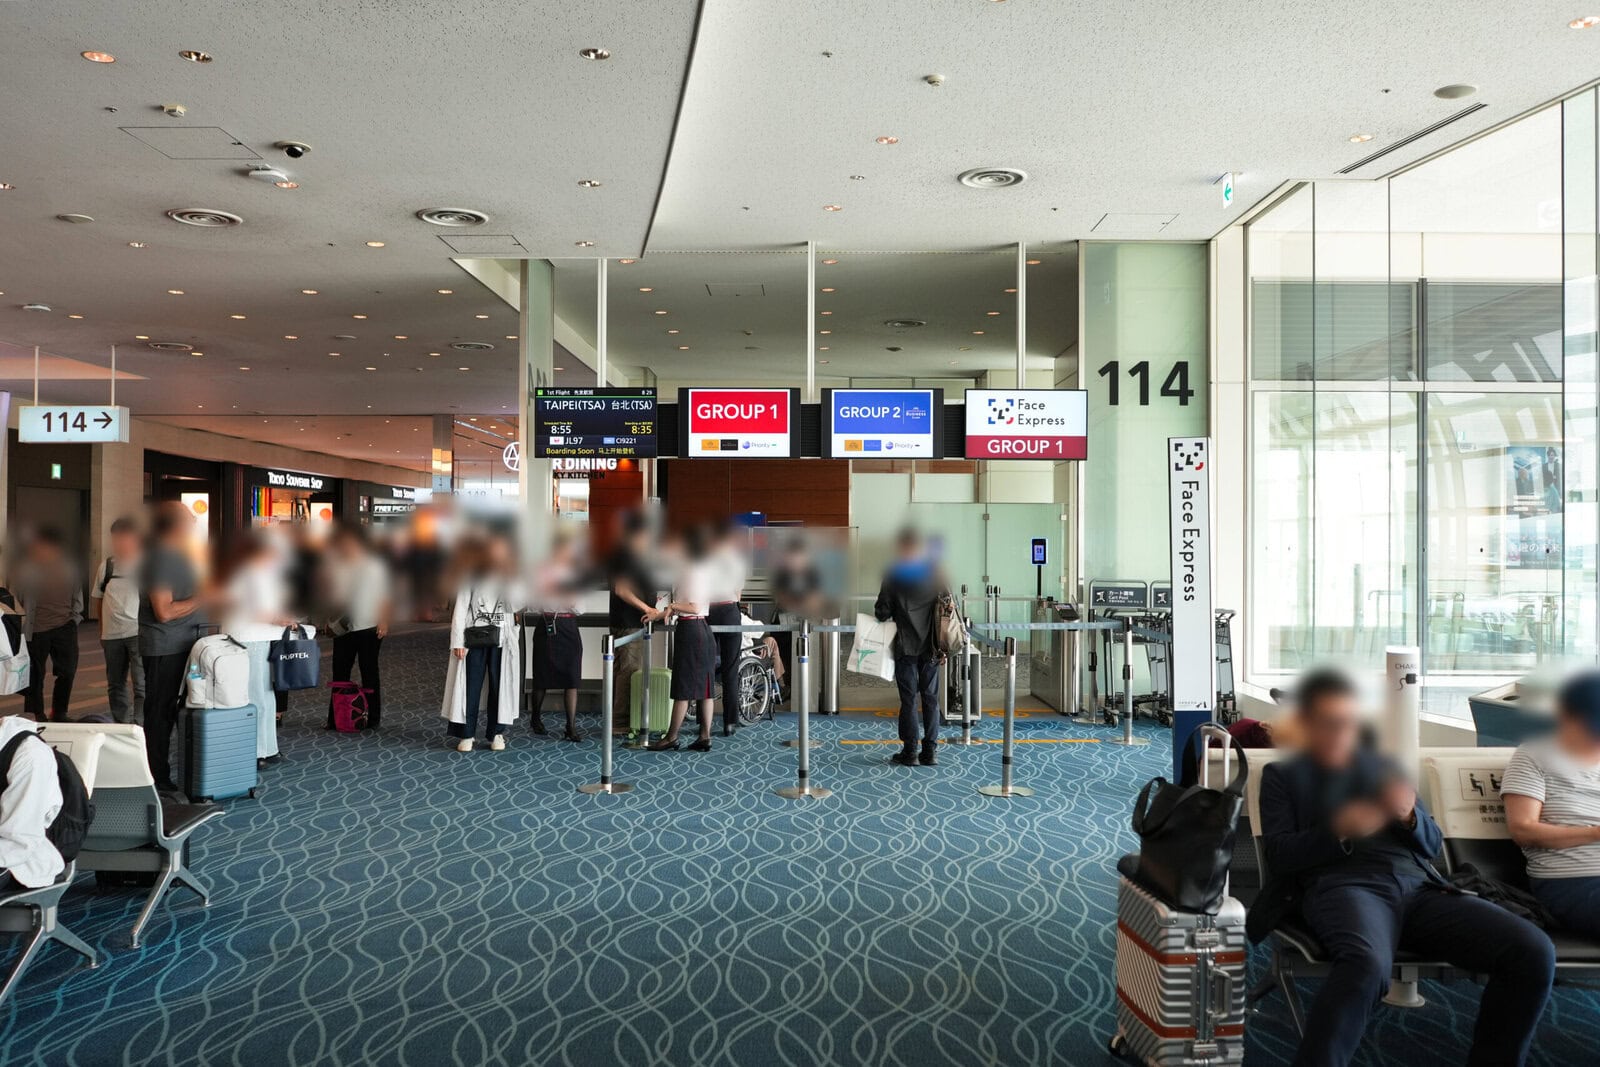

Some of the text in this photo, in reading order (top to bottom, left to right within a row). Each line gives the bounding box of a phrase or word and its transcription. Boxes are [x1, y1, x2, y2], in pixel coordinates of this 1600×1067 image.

[1098, 361, 1194, 406] 114
[544, 400, 653, 410] TAIPEI(TSA) 台北(TSA)
[1018, 399, 1046, 410] Face
[697, 404, 778, 420] GROUP 1
[840, 406, 900, 418] GROUP 2
[42, 412, 87, 432] 114
[1018, 414, 1066, 427] Express
[551, 426, 572, 434] 8:55
[632, 426, 652, 434] 8:35
[565, 437, 583, 445] JL97
[987, 440, 1062, 454] GROUP 1
[546, 448, 576, 456] Boarding
[565, 458, 618, 470] DINING
[1179, 481, 1200, 602] Face Express
